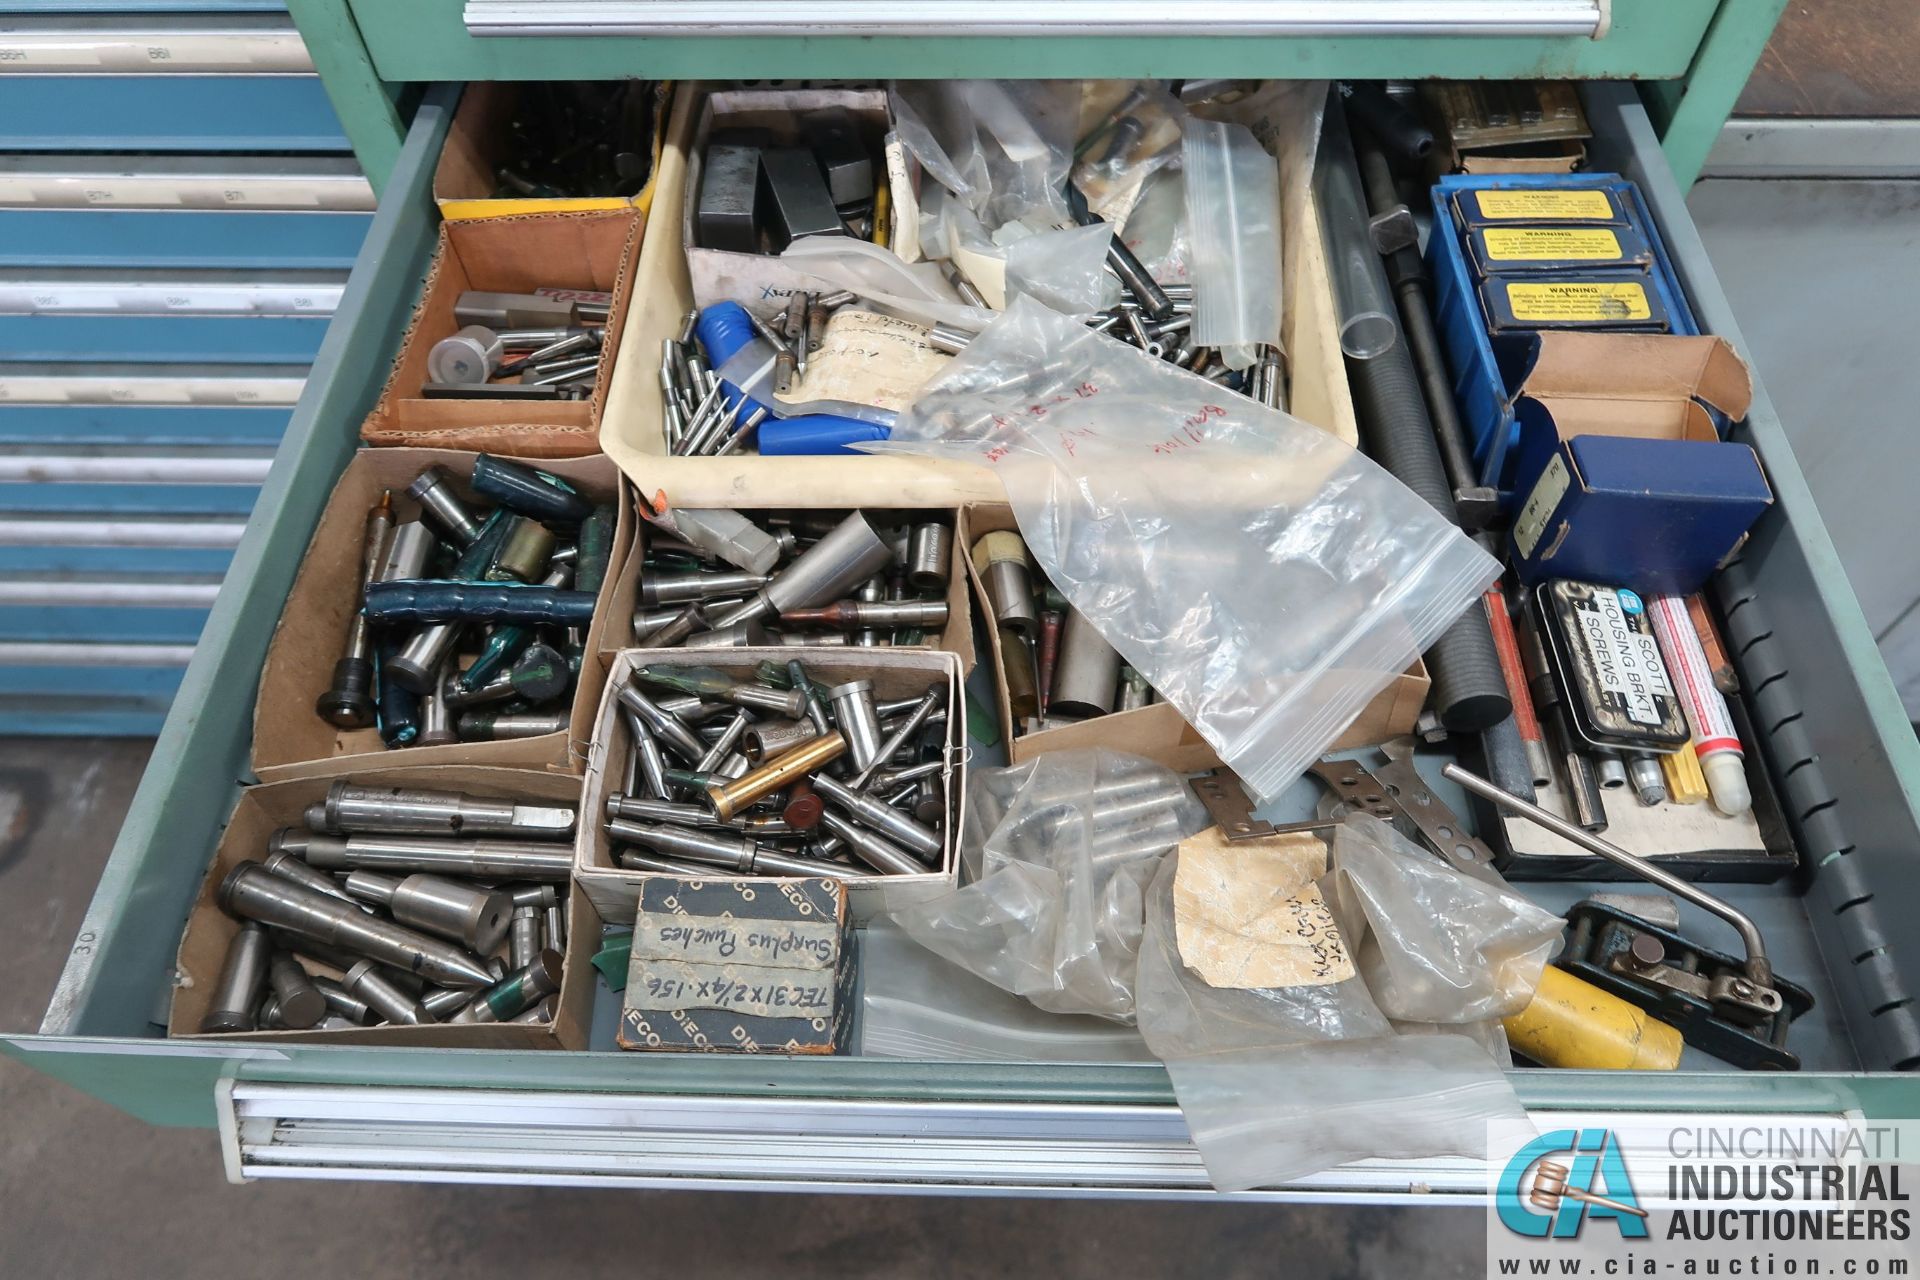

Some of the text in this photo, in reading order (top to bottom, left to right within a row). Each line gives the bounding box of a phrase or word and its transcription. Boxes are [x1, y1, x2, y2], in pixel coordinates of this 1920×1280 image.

[1586, 616, 1620, 686] SCREWS
[1601, 596, 1637, 668] HOUSING
[1627, 671, 1653, 719] BRKT.
[1638, 638, 1667, 692] SCOTT
[73, 930, 97, 955] 30
